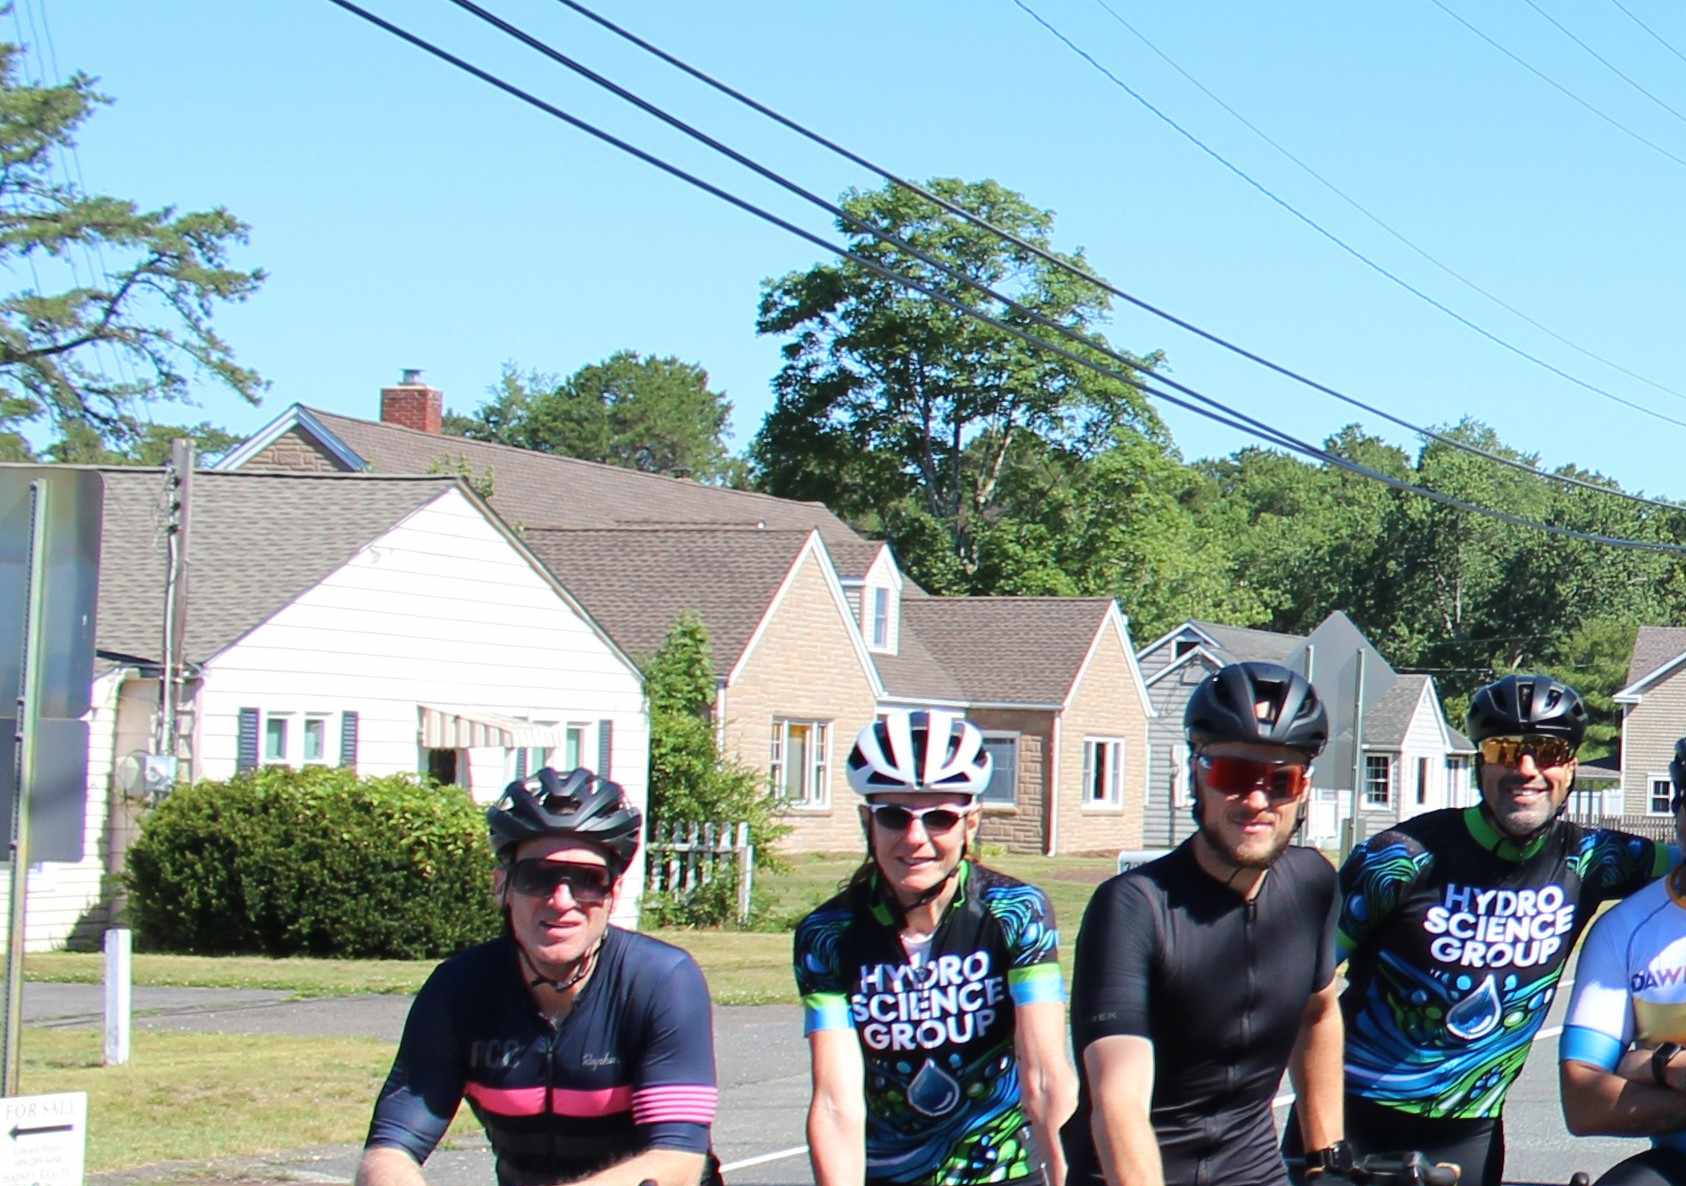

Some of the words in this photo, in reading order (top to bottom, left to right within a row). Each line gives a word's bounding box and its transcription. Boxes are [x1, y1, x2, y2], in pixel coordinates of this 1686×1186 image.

[1444, 883, 1564, 917] HYDRO
[1424, 904, 1575, 942] SCIENCE
[1430, 935, 1562, 968] GROUP
[860, 950, 990, 994] HYDRO
[851, 976, 1004, 1022] SCIENCE
[863, 1008, 996, 1051] GROUP
